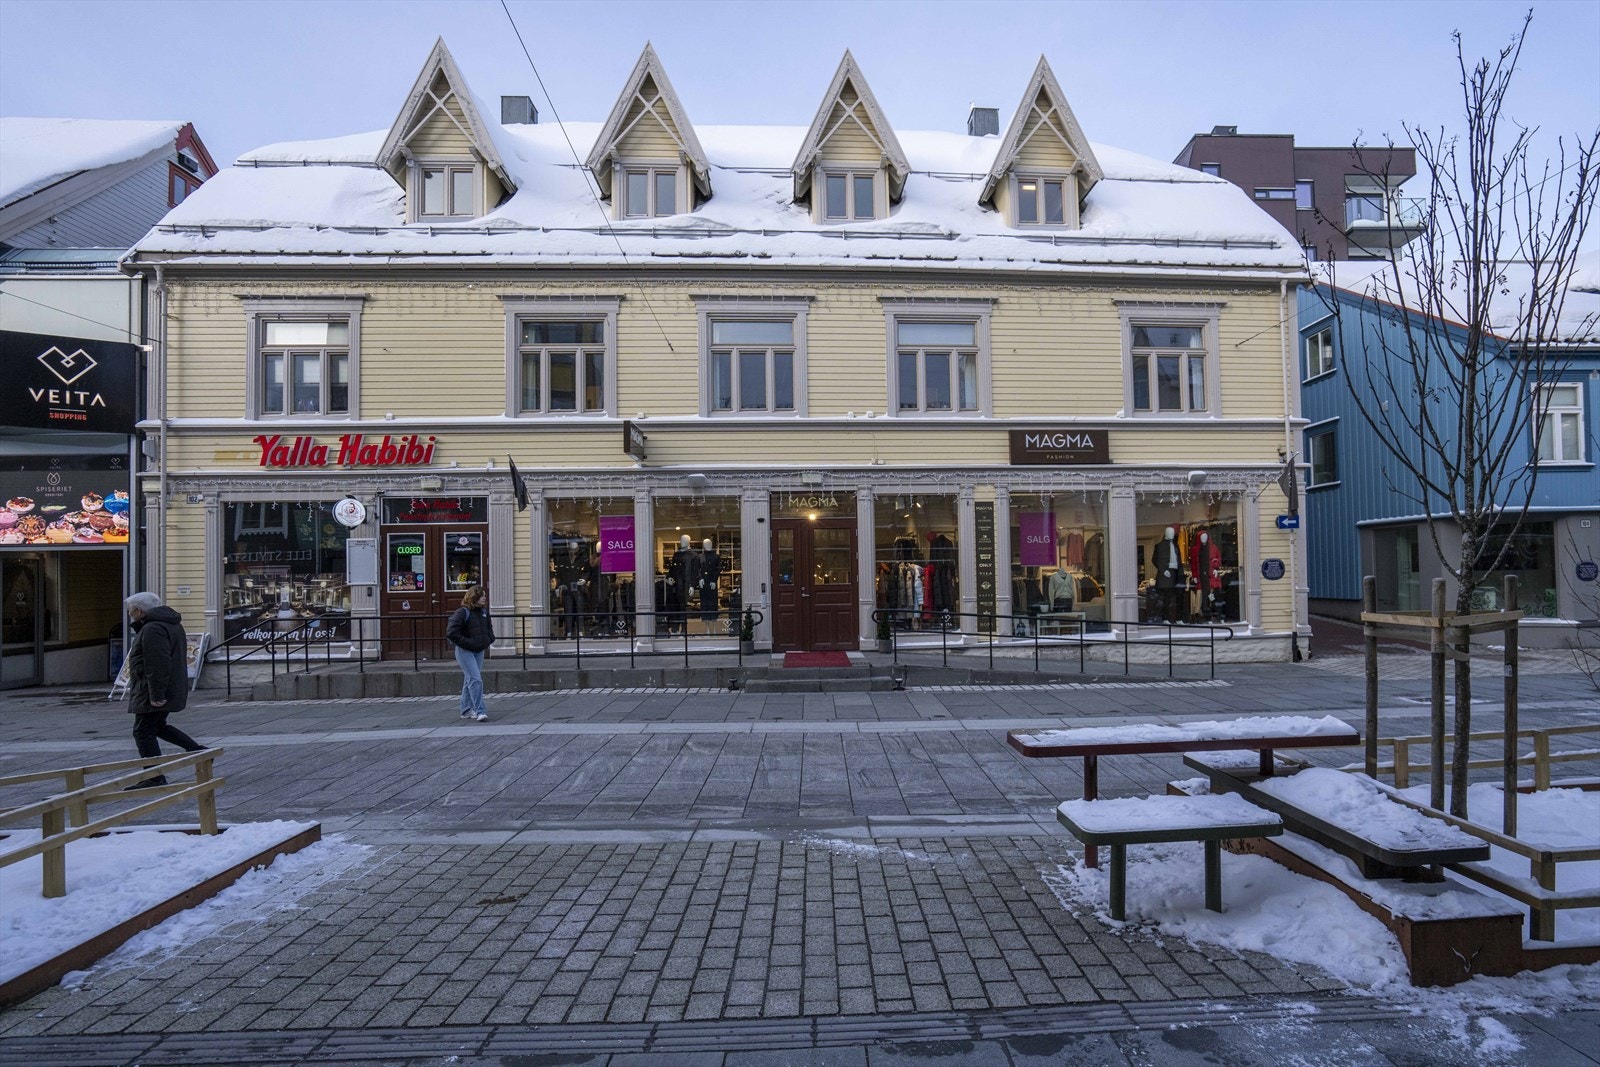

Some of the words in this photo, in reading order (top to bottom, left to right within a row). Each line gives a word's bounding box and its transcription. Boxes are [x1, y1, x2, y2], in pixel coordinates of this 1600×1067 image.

[28, 387, 106, 407] VEITA
[49, 412, 87, 421] SHOPPING
[1025, 433, 1094, 448] MAGMA
[253, 434, 330, 467] Yalla
[336, 433, 437, 466] Habibi
[788, 496, 839, 508] MAGMA
[607, 540, 634, 550] SALG
[1026, 535, 1051, 544] SALG
[397, 546, 422, 554] CLOSED
